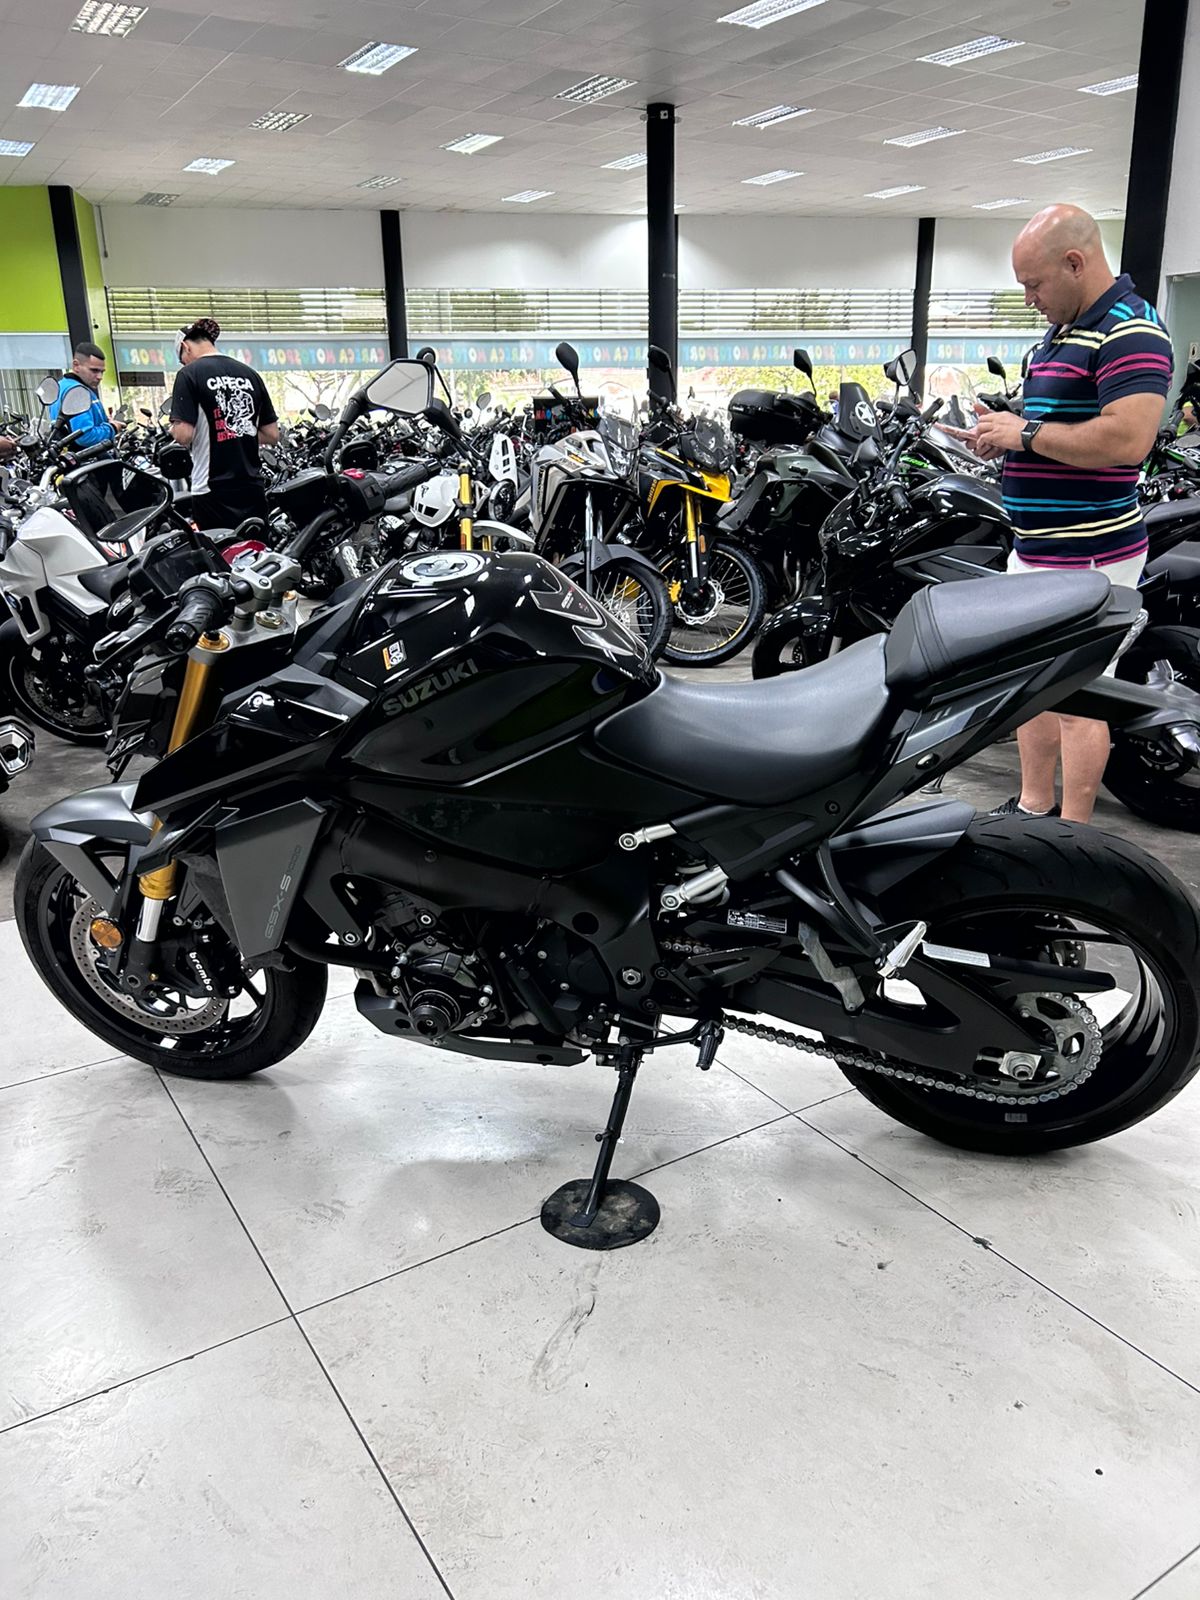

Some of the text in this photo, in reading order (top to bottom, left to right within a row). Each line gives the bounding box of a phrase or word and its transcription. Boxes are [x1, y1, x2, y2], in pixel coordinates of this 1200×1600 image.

[382, 658, 479, 716] SUZUKI
[265, 873, 292, 939] GSX-S
[189, 951, 213, 991] brembo
